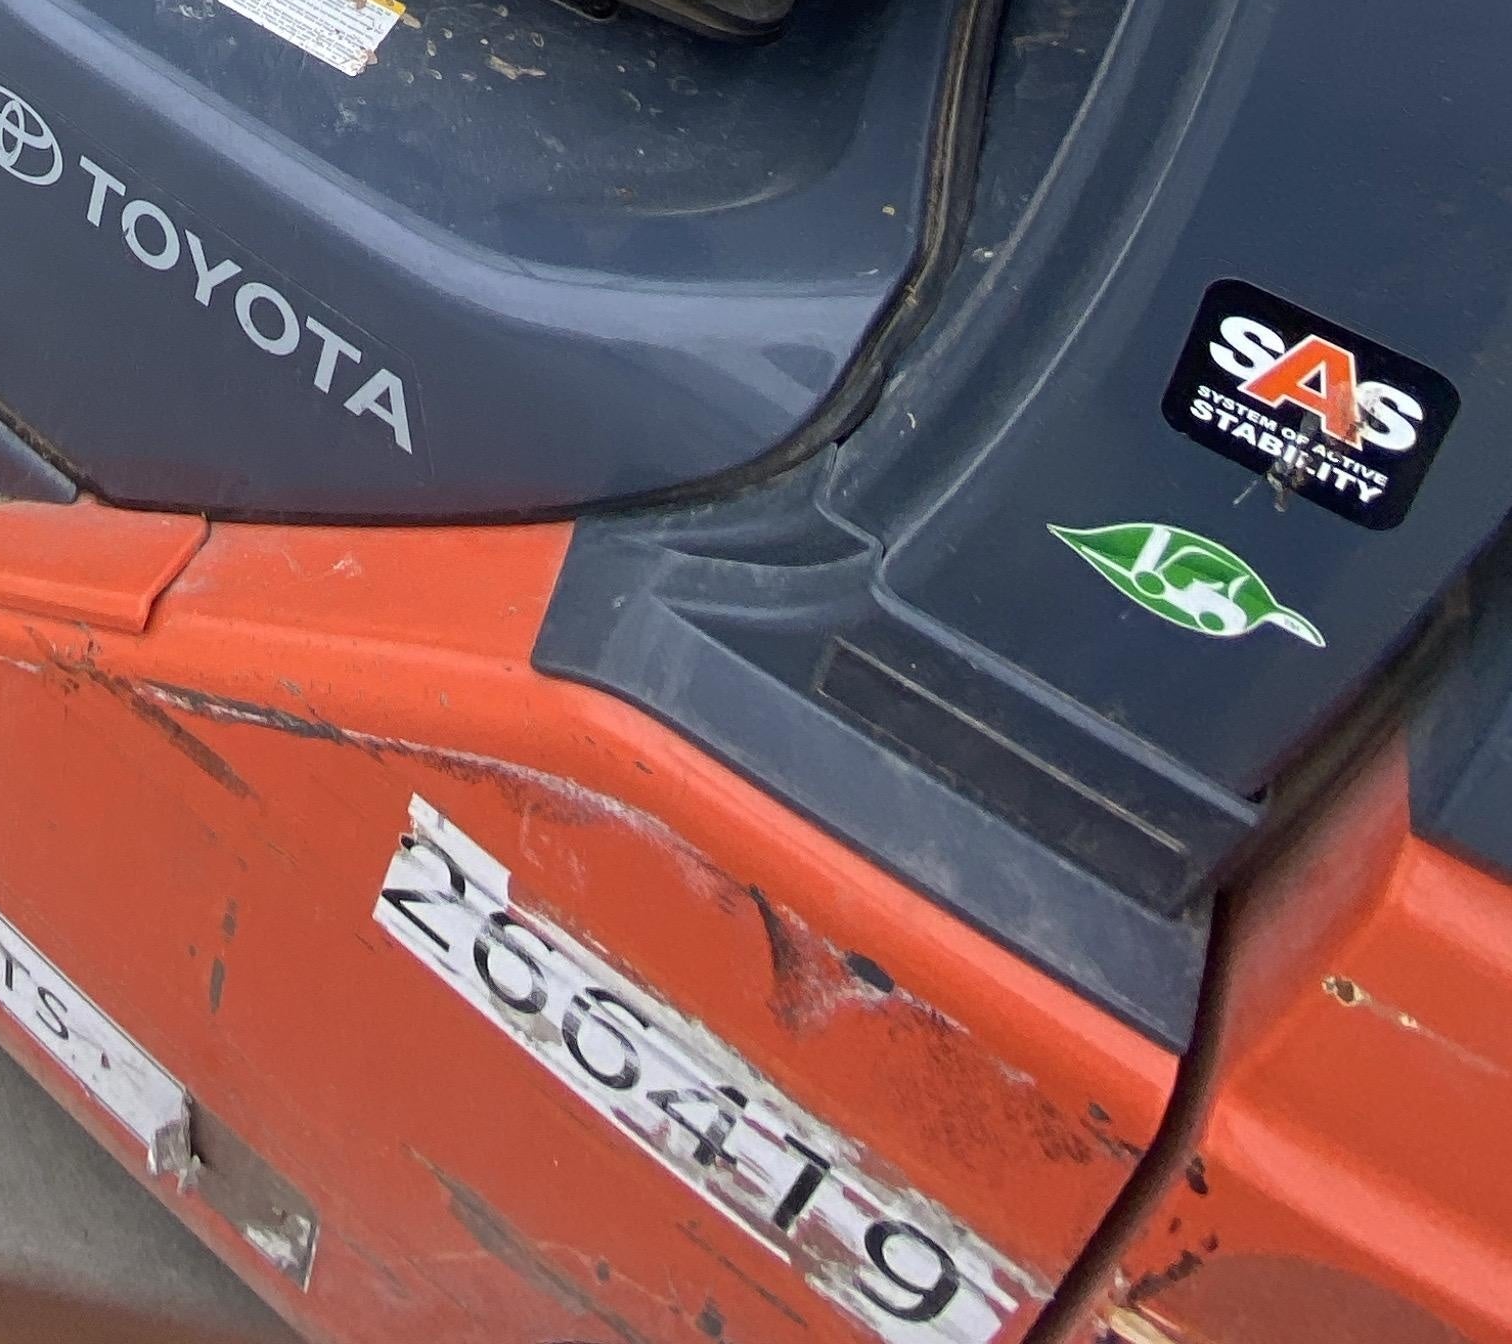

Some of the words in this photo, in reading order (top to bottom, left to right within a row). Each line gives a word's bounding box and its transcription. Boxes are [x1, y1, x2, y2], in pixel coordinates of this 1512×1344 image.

[79, 155, 413, 455] TOYOTA
[1189, 397, 1384, 505] STABILITY
[1197, 385, 1278, 432] SYSTEM
[1280, 426, 1311, 445] OF
[1311, 443, 1389, 488] ACTIVE
[1209, 315, 1424, 451] SAS
[380, 834, 961, 1323] 266419
